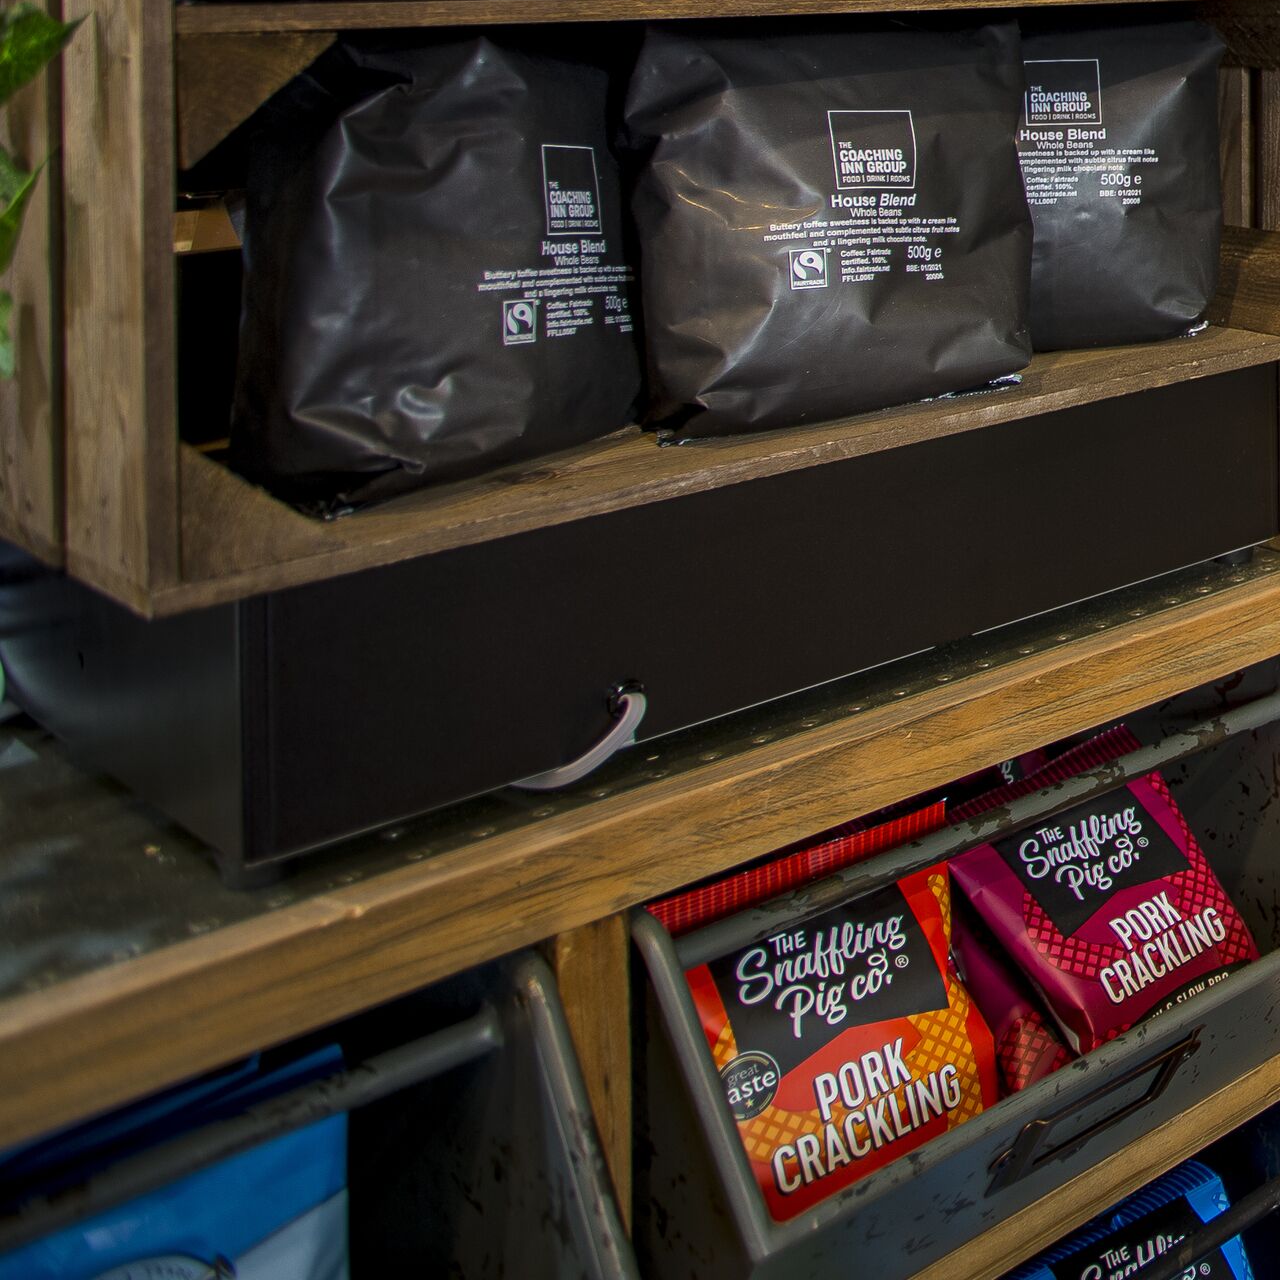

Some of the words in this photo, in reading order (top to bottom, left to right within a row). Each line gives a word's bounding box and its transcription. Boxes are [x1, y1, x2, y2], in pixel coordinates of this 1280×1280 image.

[1030, 92, 1087, 103] COACHING
[1031, 102, 1051, 113] INN
[1053, 102, 1092, 113] GROUP
[1020, 130, 1064, 141] House
[1067, 128, 1106, 140] Blend
[1036, 141, 1064, 149] Whole
[1066, 141, 1094, 149] Beans
[839, 148, 903, 162] COACHING
[841, 162, 864, 174] INN
[866, 161, 907, 174] GROUP
[1100, 173, 1131, 187] 500g
[549, 191, 591, 204] COACHING
[831, 194, 876, 208] House
[880, 193, 916, 207] Blend
[550, 205, 567, 218] INN
[568, 205, 595, 217] GROUP
[850, 208, 878, 217] Whole
[878, 207, 902, 216] Beans
[541, 240, 579, 256] House
[580, 239, 606, 254] Blend
[907, 246, 931, 261] 500g
[1019, 806, 1143, 879] Snaffling
[1035, 826, 1064, 845] THE
[1055, 860, 1113, 901] Pig
[1108, 891, 1182, 951] PORK
[769, 930, 808, 956] THE
[736, 914, 907, 1005] Snaffling
[1099, 907, 1226, 1004] CRACKLING
[775, 982, 848, 1038] Pig
[727, 1068, 778, 1106] aste
[813, 1037, 913, 1121] PORK
[771, 1063, 962, 1195] CRACKLING
[1100, 1245, 1131, 1270] THE
